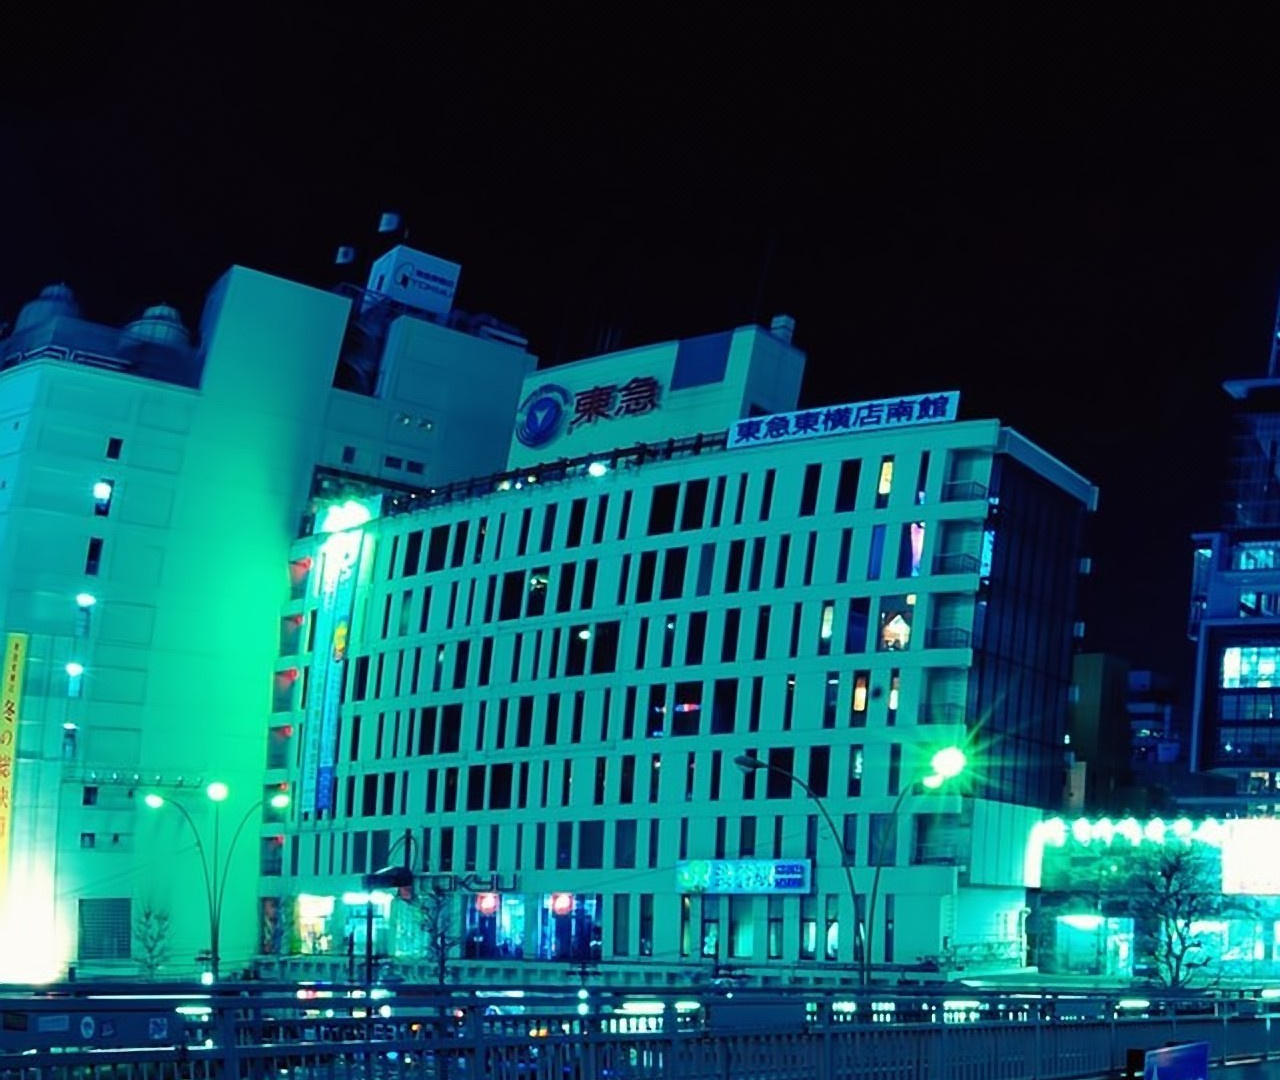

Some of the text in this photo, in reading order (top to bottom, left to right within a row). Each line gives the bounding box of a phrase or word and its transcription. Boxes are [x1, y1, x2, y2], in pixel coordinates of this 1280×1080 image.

[568, 376, 658, 427] 東急
[734, 395, 950, 443] 東急東横店南館
[414, 873, 517, 892] TOKYU
